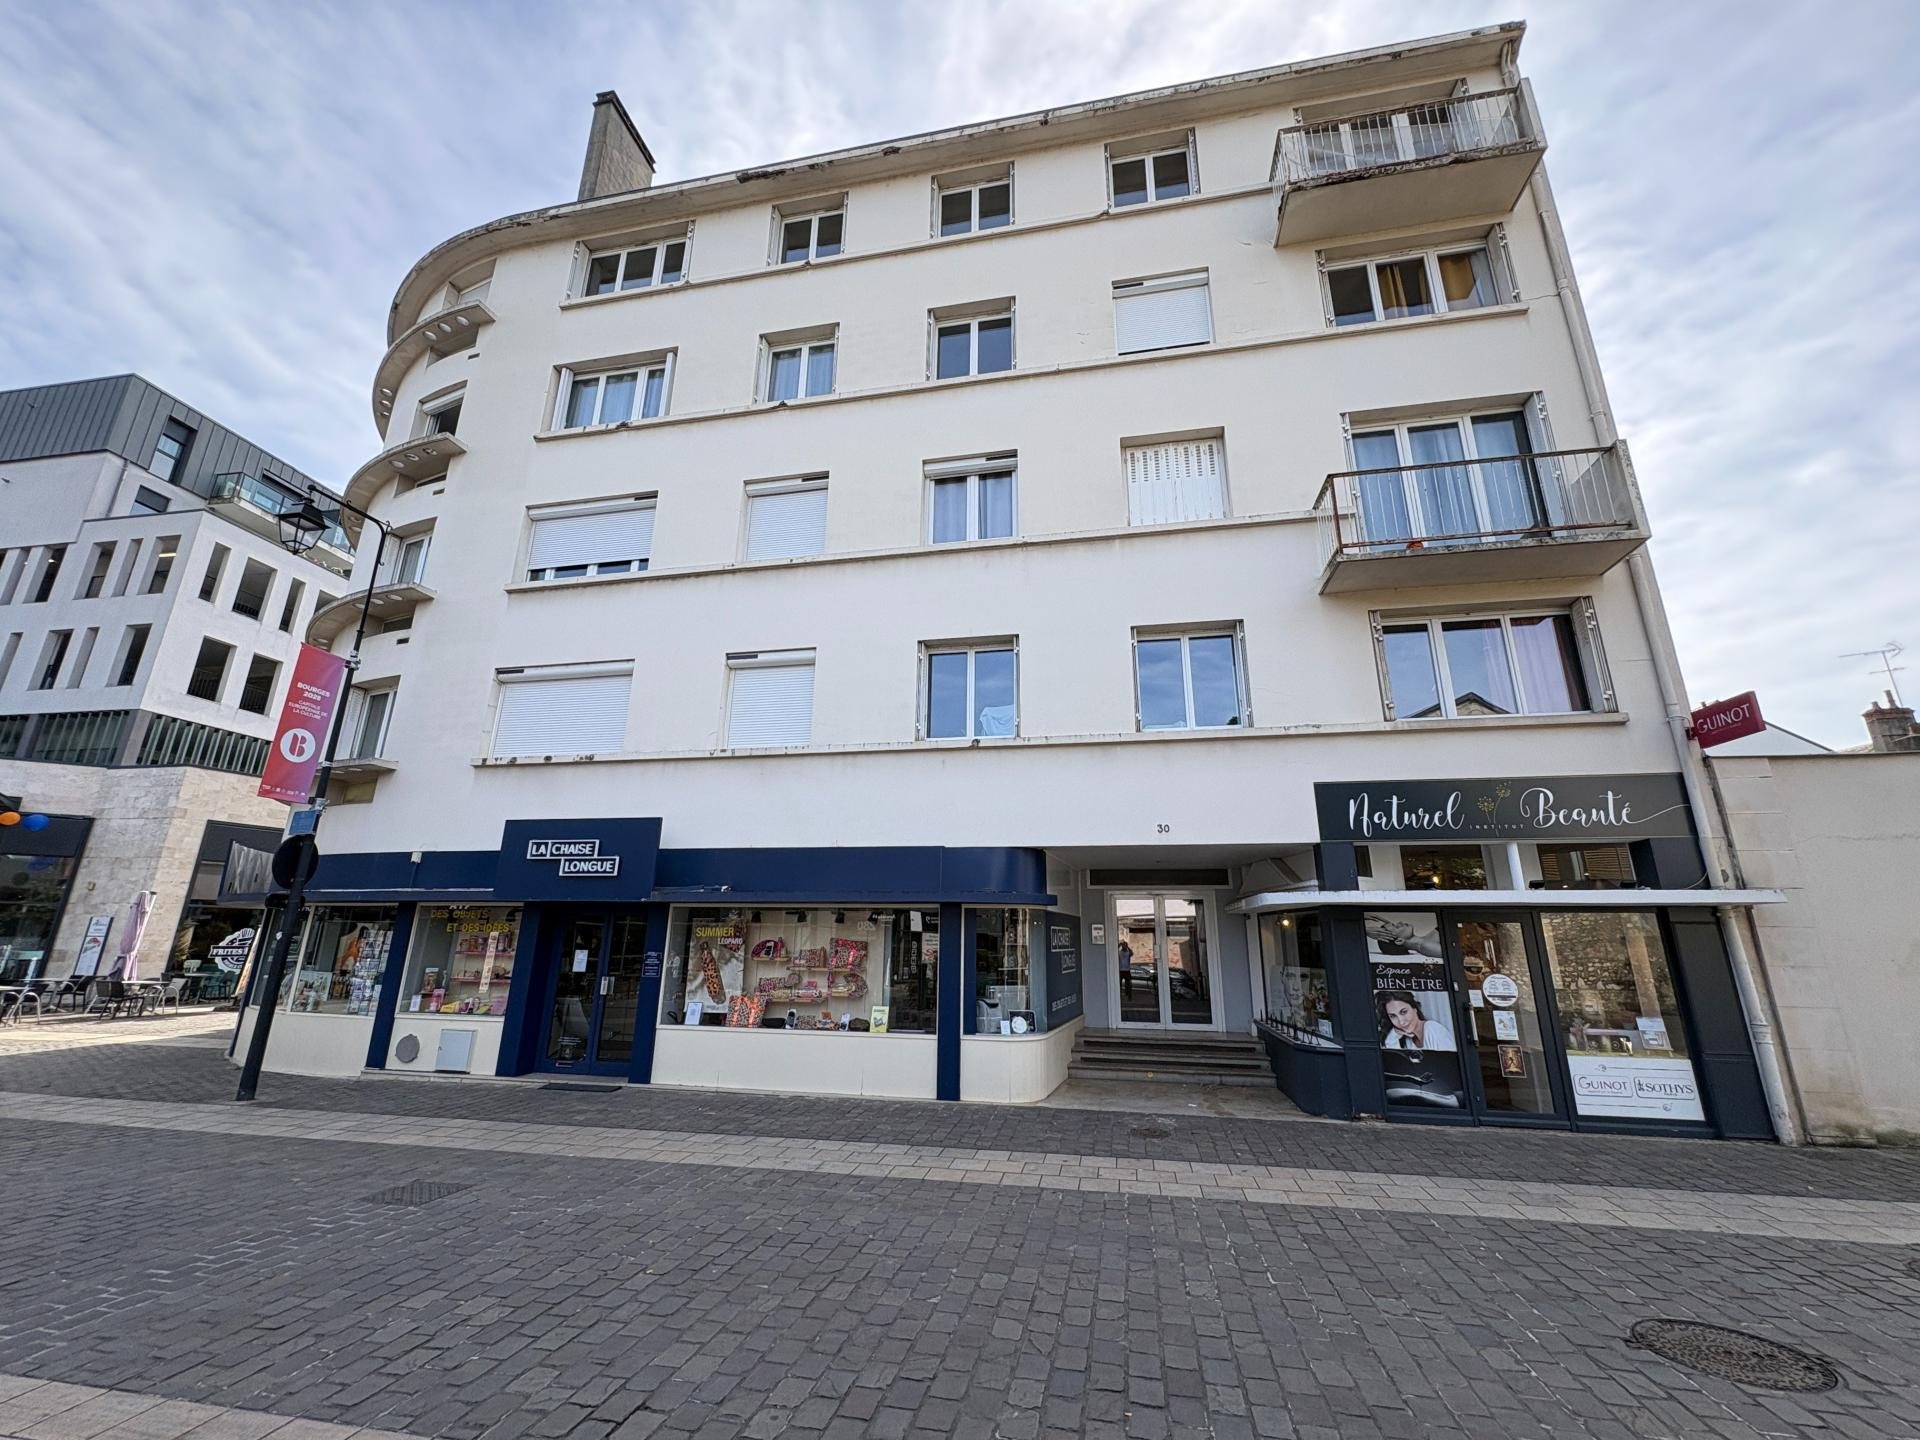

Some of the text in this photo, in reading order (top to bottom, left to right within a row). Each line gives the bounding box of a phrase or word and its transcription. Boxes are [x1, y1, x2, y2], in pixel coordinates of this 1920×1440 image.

[297, 682, 330, 697] BOURGES
[1696, 703, 1750, 734] GUINOT
[1349, 787, 1646, 837] Naturel Beauté
[1157, 824, 1170, 833] 30
[531, 843, 594, 855] LA CHAISE
[564, 860, 615, 873] LONGUE
[431, 909, 449, 918] DES
[446, 923, 458, 933] ET
[462, 923, 480, 933] DES
[695, 927, 734, 937] SUMMER
[212, 948, 244, 956] FRITES
[1375, 964, 1411, 977] Espace
[1377, 977, 1443, 990] BIEN-ÊTRE
[1645, 1083, 1694, 1093] SOTHYS
